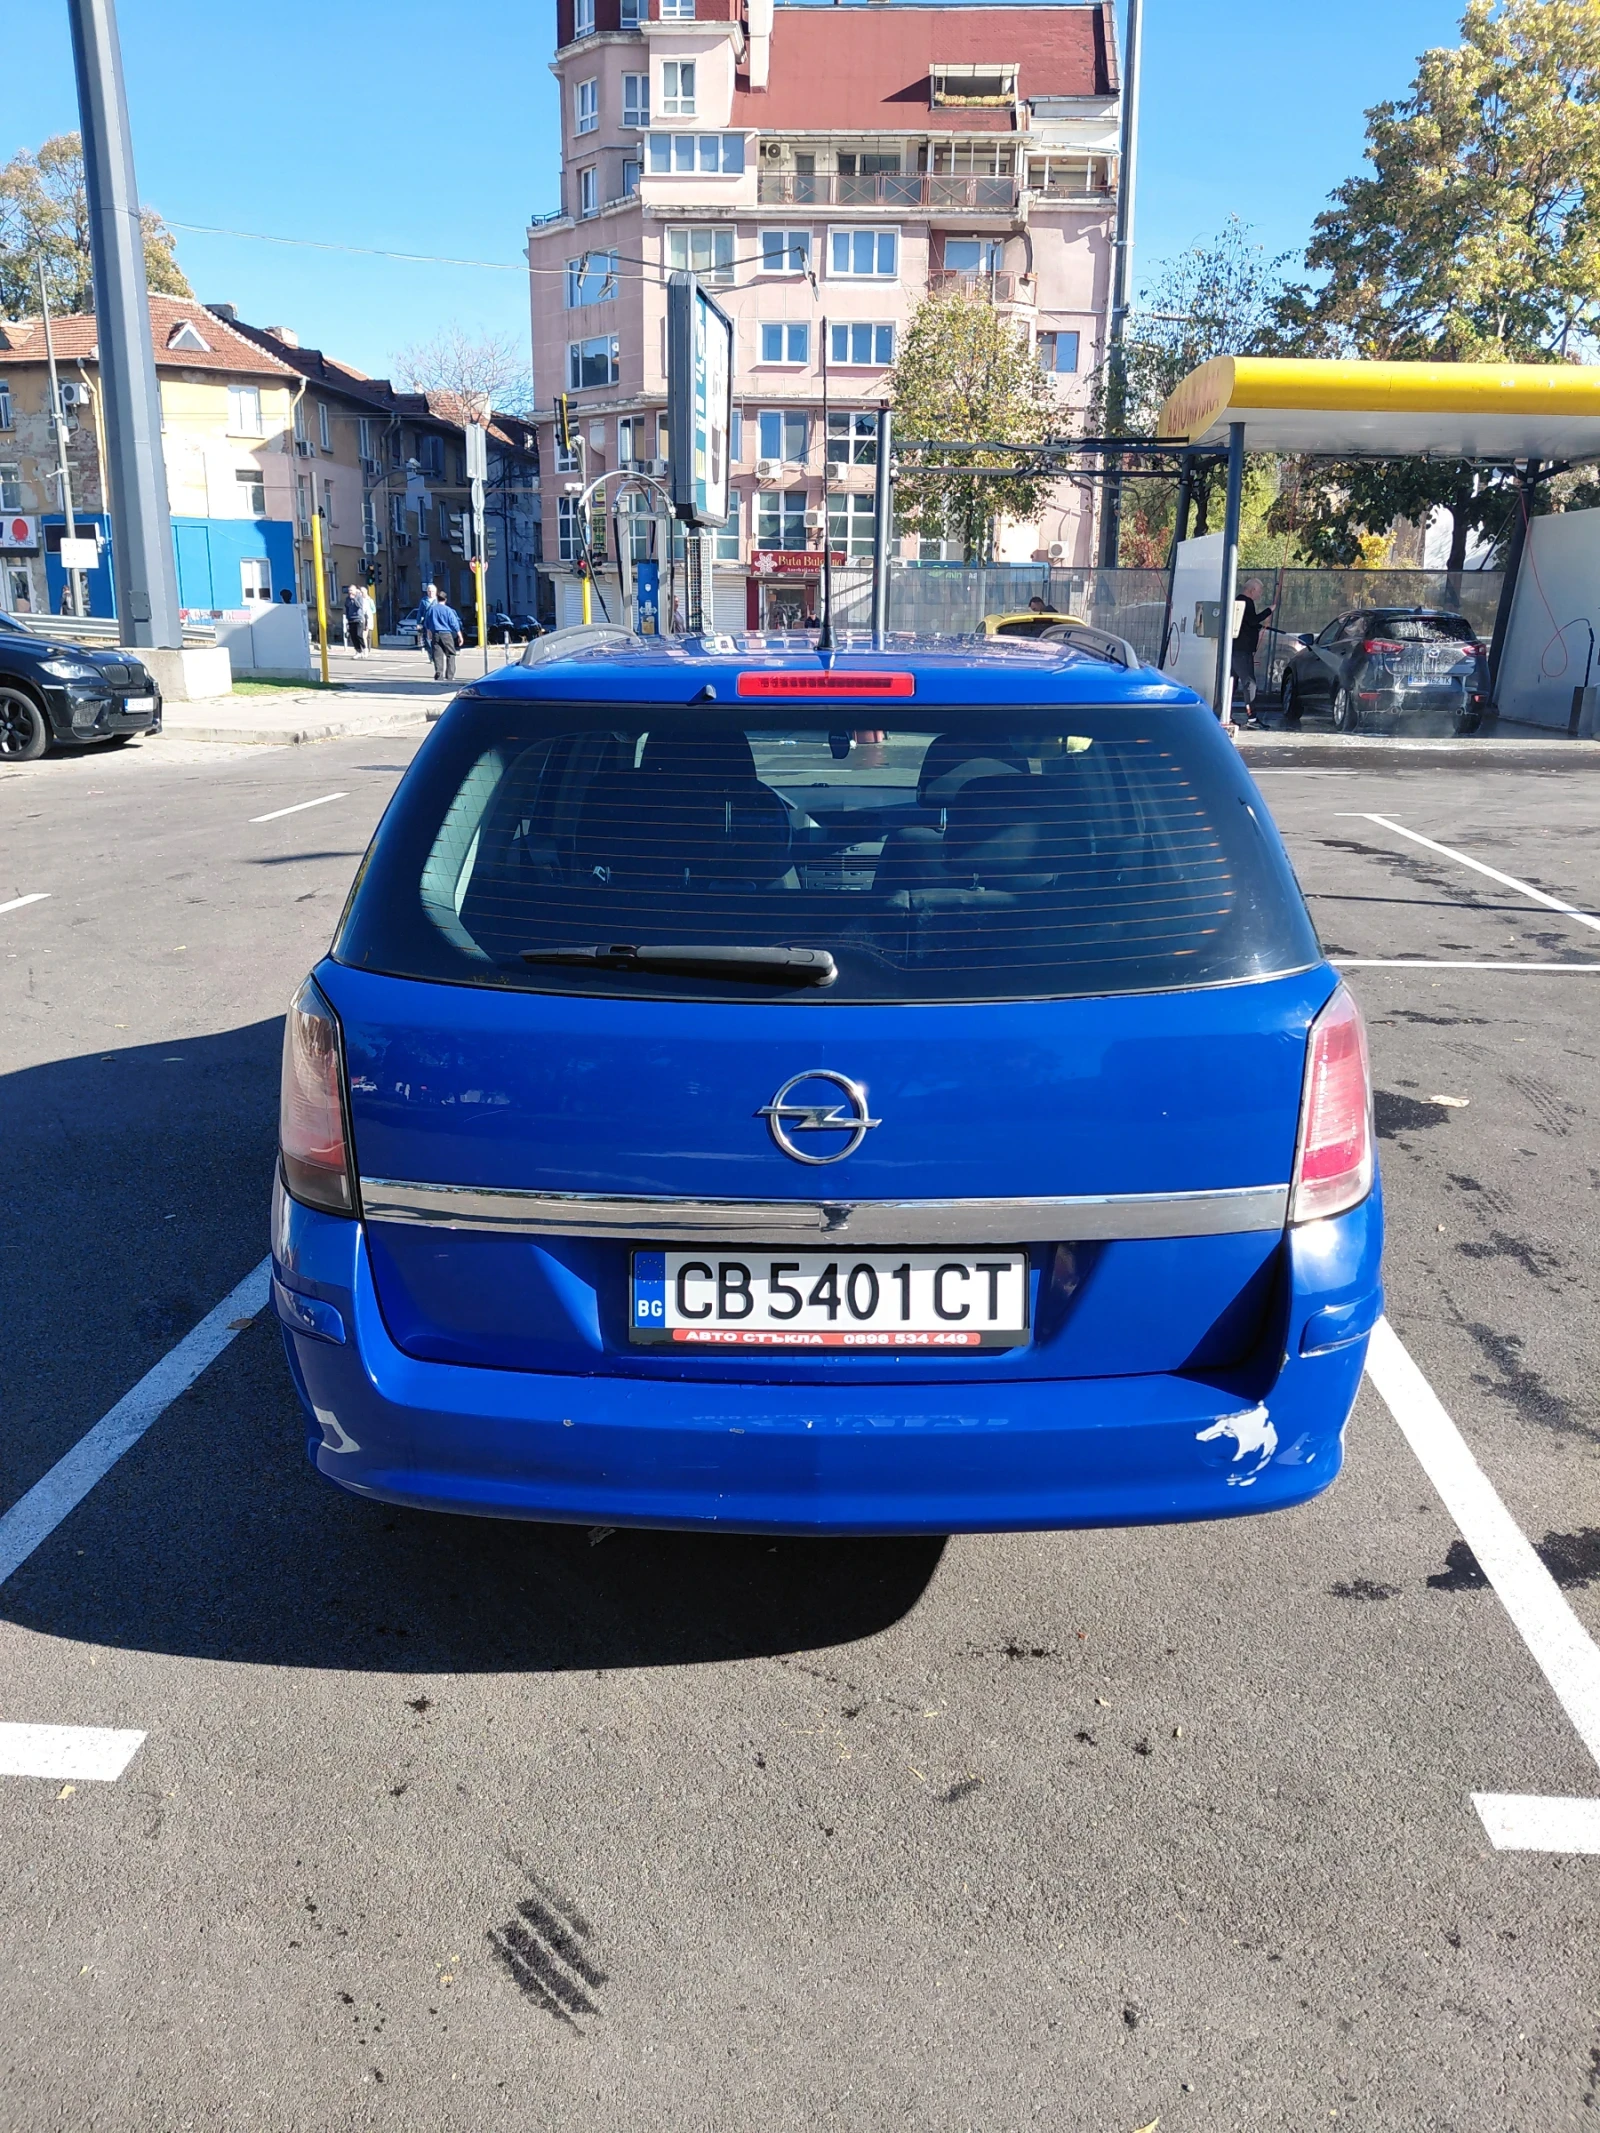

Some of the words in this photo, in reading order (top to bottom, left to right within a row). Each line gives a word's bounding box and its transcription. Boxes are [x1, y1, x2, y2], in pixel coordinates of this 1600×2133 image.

[778, 556, 802, 566] Buta
[638, 1300, 663, 1317] BG
[685, 1331, 739, 1342] АВТО
[743, 1333, 824, 1344] СТЪКЛА
[843, 1333, 889, 1344] 0898
[895, 1333, 929, 1344] 534
[933, 1333, 968, 1344] 449
